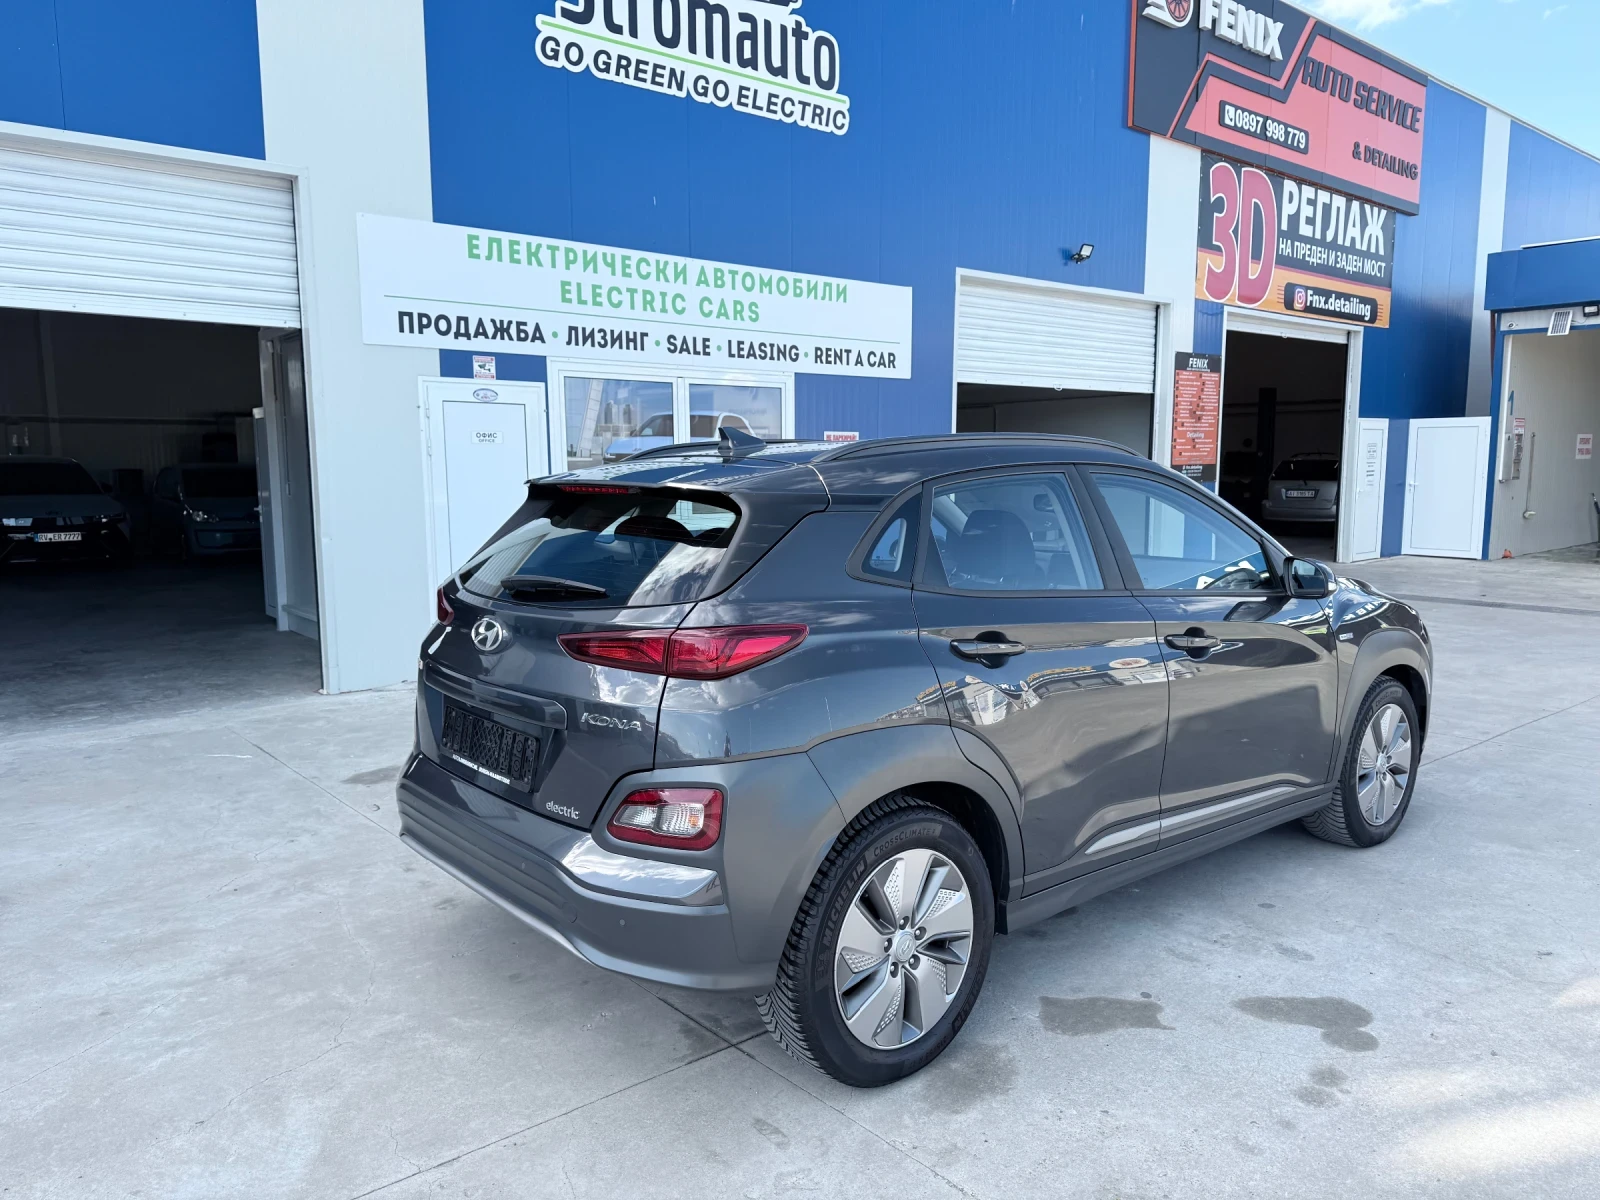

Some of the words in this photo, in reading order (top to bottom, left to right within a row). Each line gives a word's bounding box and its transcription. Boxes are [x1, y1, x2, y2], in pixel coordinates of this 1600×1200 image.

[1199, 0, 1284, 61] FENIX
[540, 36, 584, 66] GO
[593, 49, 685, 92] GREEN
[692, 75, 730, 101] GO
[736, 85, 847, 131] ELECTRIC
[1302, 56, 1352, 103] AUTO
[1353, 81, 1422, 133] SERVICE
[1235, 110, 1264, 134] 0897
[1265, 120, 1285, 142] 998
[1287, 128, 1306, 148] 779
[1352, 141, 1362, 160] &
[1363, 145, 1419, 180] DETAILING
[1204, 161, 1278, 307] 3D
[1281, 180, 1388, 256] РЕГЛАЖ
[466, 233, 689, 285] ЕЛЕКТРИЧЕСКИ
[695, 264, 848, 304] АВТОМОБИЛИ
[1278, 237, 1293, 256] НА
[1293, 241, 1328, 266] ПРЕДЕН
[1328, 253, 1336, 267] И
[1335, 254, 1363, 276] ЗАДЕН
[1363, 260, 1386, 278] МОСТ
[559, 279, 688, 316] ELECTRIC
[698, 295, 761, 323] CARS
[1306, 290, 1371, 320] Fnx.detailing
[397, 310, 547, 345] ПРОДАЖБА
[565, 325, 650, 352] ЛИЗИНГ
[666, 333, 712, 357] SALE
[727, 338, 801, 363] LEASING
[813, 346, 852, 367] RENT
[853, 349, 864, 367] A
[866, 350, 898, 369] CAR
[1188, 357, 1209, 369] FENIX
[580, 711, 643, 732] KONA
[545, 800, 580, 820] electric
[822, 861, 868, 948] MICHELIN
